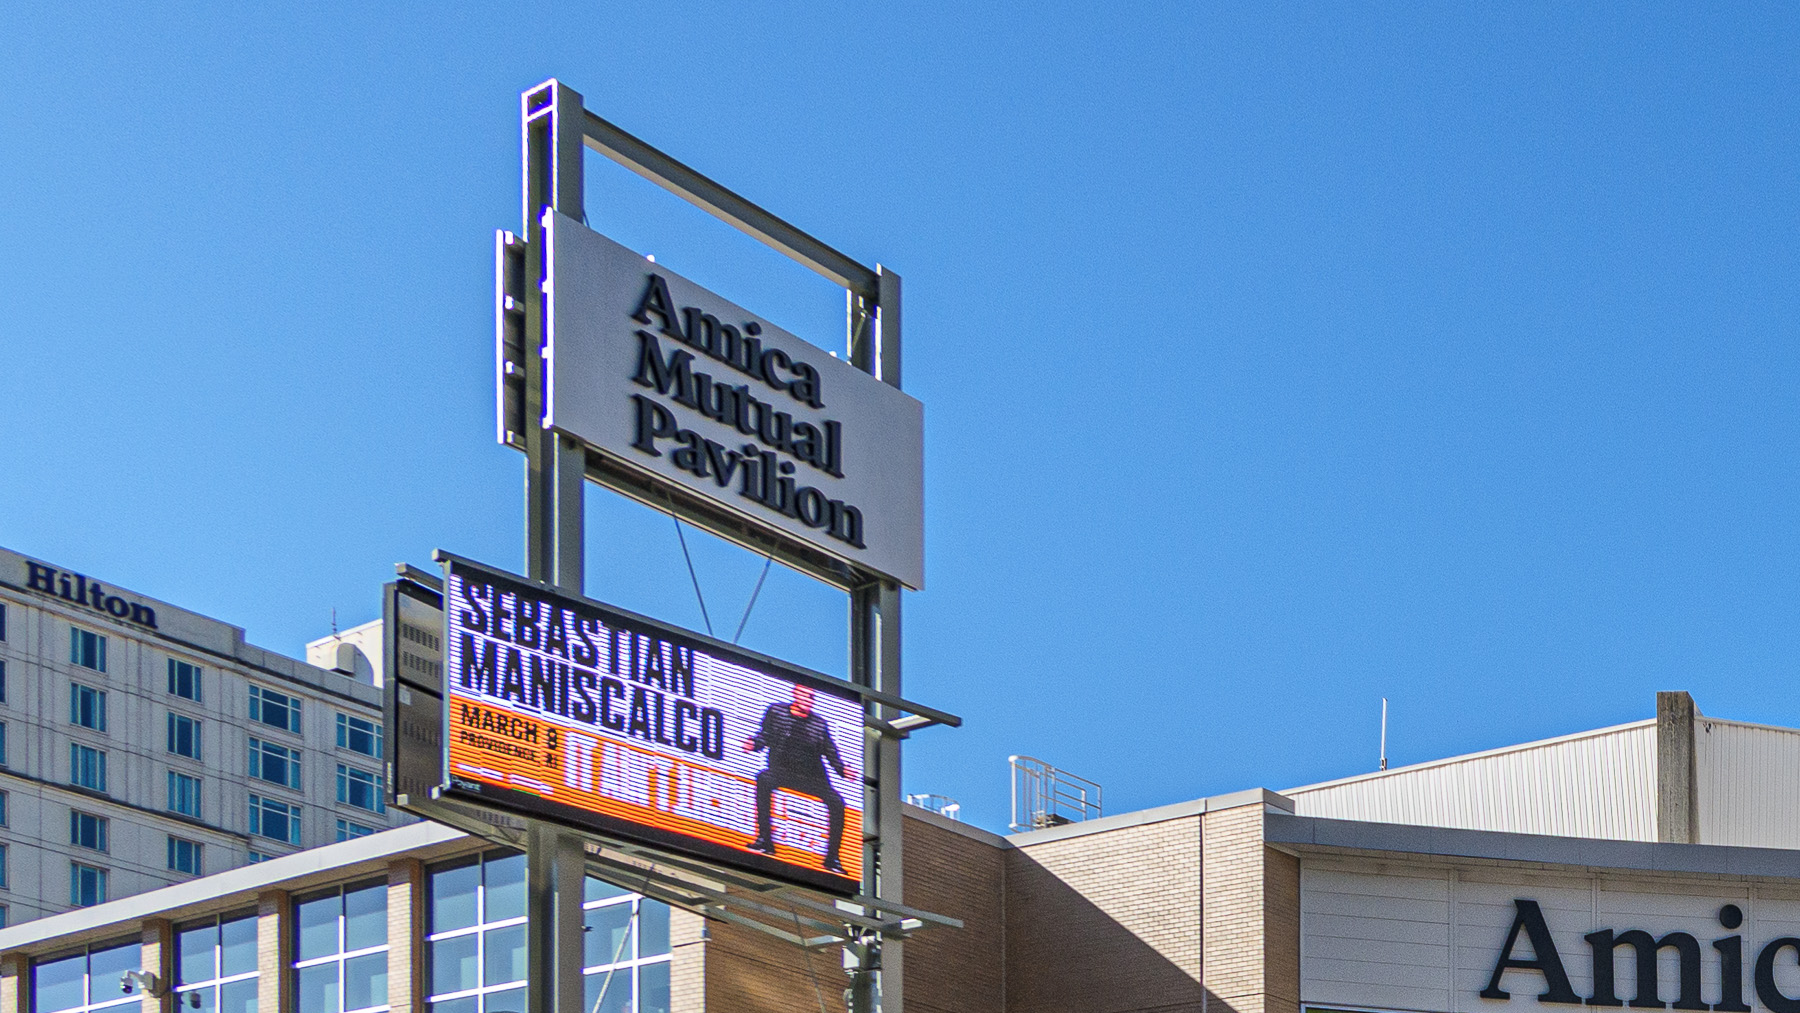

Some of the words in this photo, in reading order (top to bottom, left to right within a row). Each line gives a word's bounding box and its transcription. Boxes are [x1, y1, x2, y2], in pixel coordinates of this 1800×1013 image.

[630, 273, 825, 409] Amica
[631, 330, 845, 479] Mutual
[629, 394, 867, 549] Pavilion
[26, 560, 158, 629] Hilton
[461, 578, 695, 700] SEBASTIAN
[461, 633, 724, 760] MANISCALCO
[461, 703, 537, 744] MARCH
